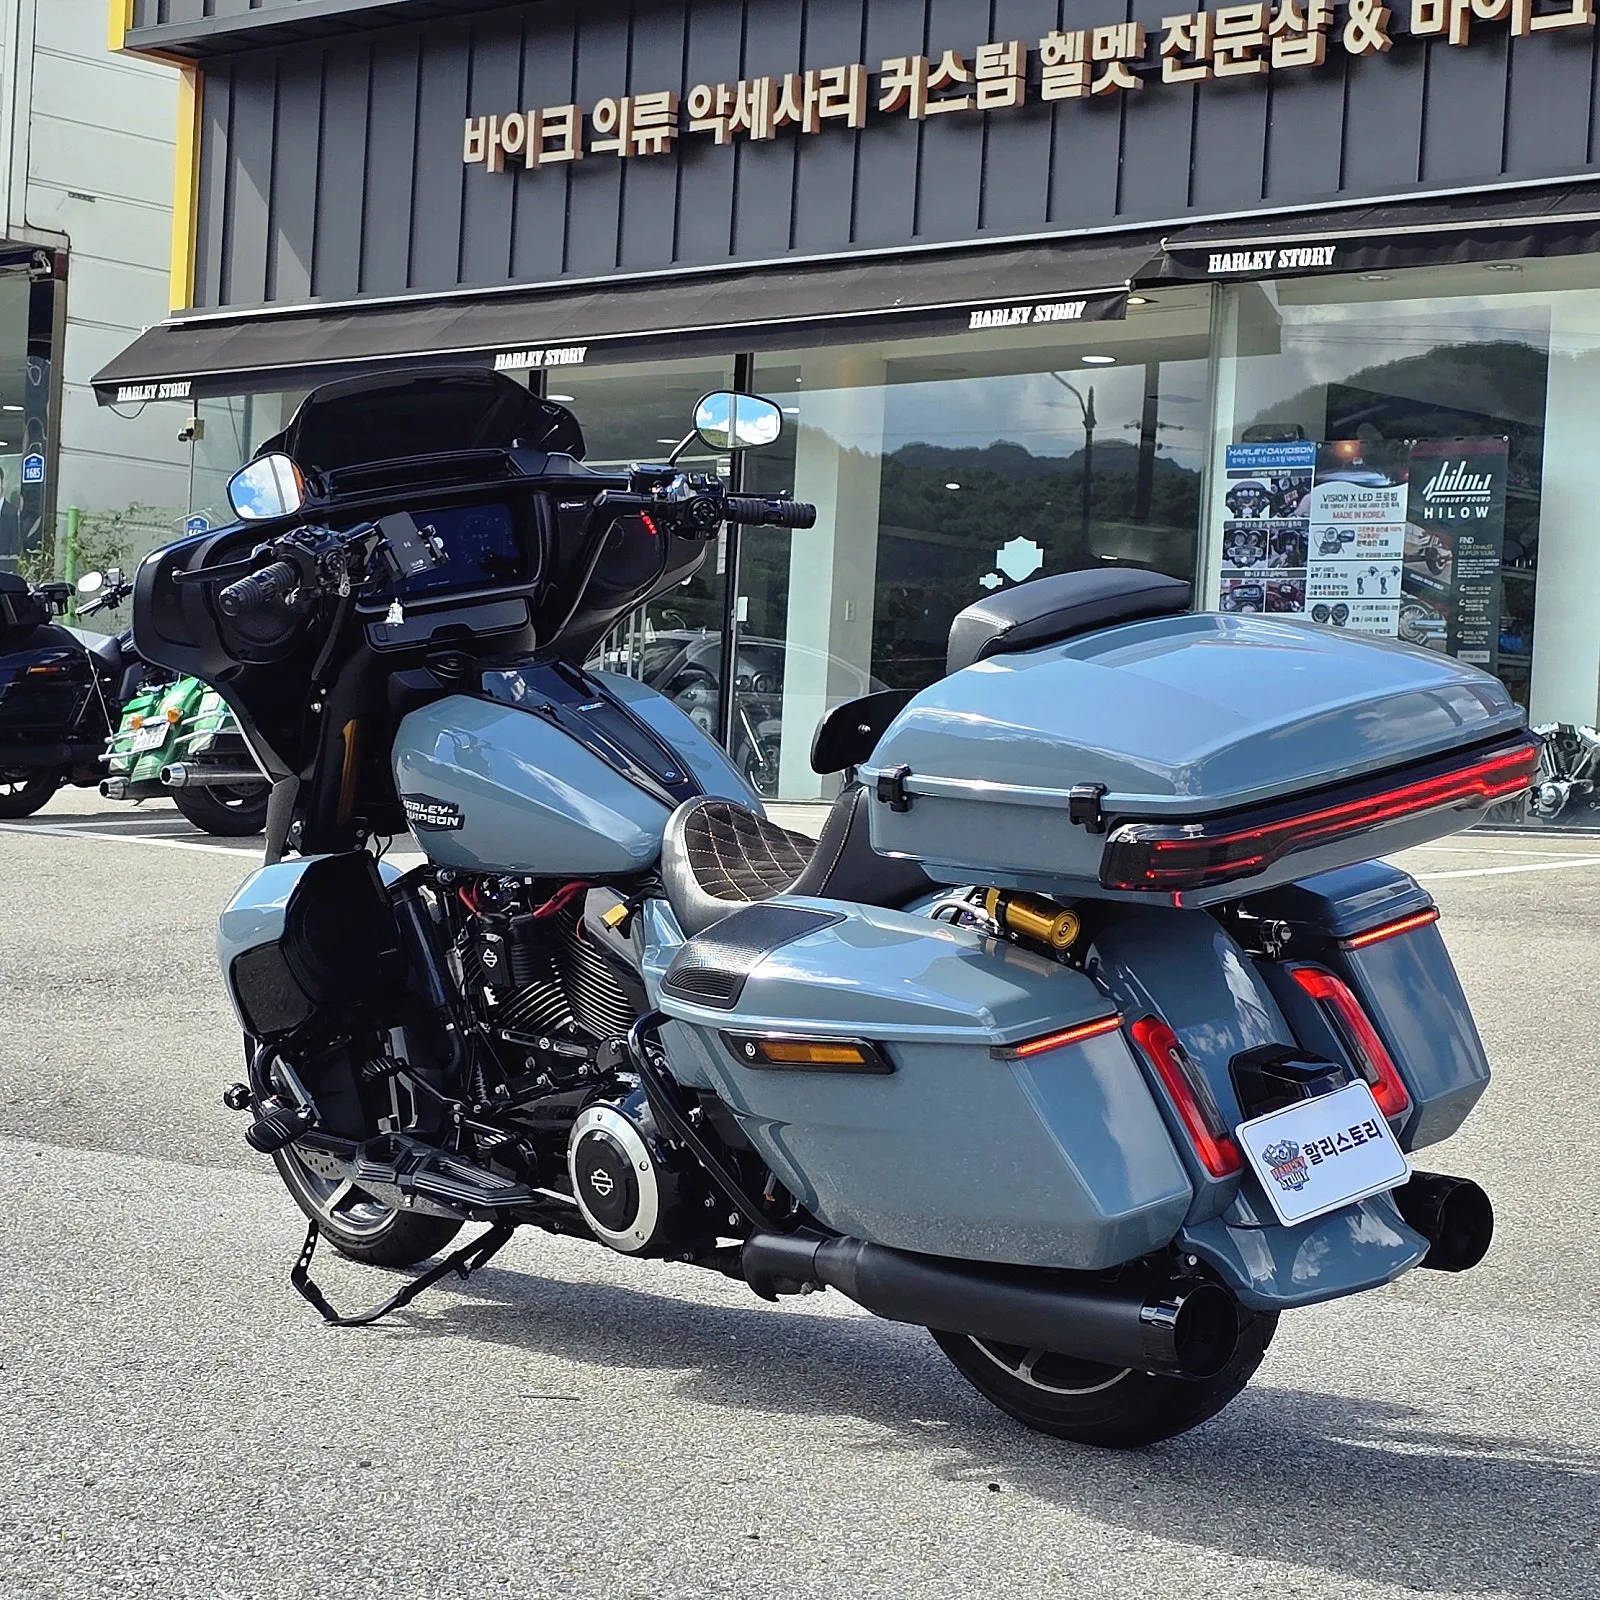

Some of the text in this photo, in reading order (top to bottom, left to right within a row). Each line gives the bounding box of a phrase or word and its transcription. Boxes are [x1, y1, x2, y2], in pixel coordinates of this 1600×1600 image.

[464, 104, 581, 173] 바이크
[590, 91, 677, 157] 의류
[687, 63, 865, 145] 악세사리
[879, 41, 1025, 120] 커스텀
[1040, 21, 1143, 101] 헬멧
[1160, 0, 1333, 84] 전문샵
[1343, 0, 1393, 57] &
[1208, 246, 1336, 273] HARLEY STORY
[969, 301, 1087, 329] HARLEY STORY
[494, 347, 587, 371] HARLEY STORY
[117, 381, 191, 401] HARLEY STORY
[1322, 493, 1348, 502] VISION
[1350, 493, 1356, 501] X
[1358, 493, 1373, 501] LED
[1333, 511, 1352, 519] MADE
[1424, 506, 1489, 519] HILOW
[403, 800, 454, 815] ARLEY-
[406, 810, 459, 826] VIDSON
[1302, 1118, 1383, 1166] 할리스토리
